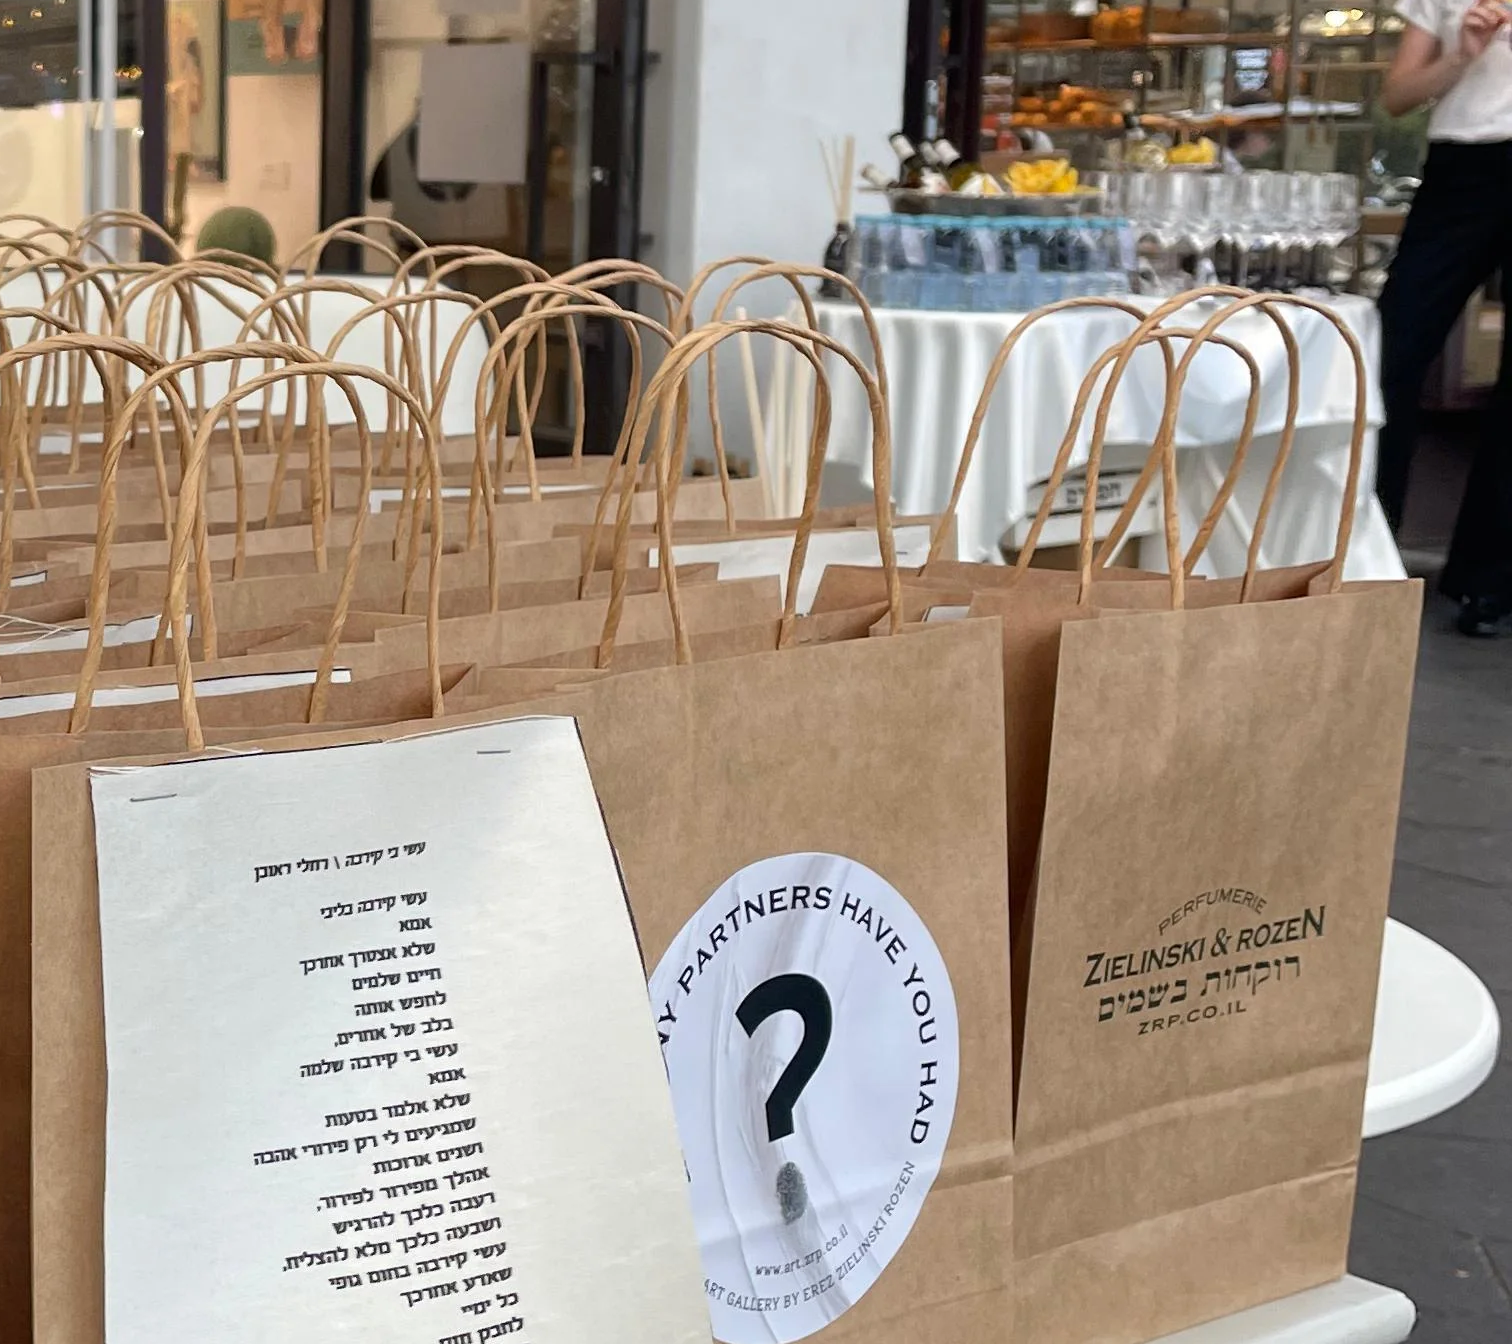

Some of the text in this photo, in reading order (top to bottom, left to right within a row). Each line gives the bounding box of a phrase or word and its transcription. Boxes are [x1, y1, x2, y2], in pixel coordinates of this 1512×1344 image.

[676, 885, 833, 997] PARTNERS
[840, 893, 908, 965] HAVE
[1083, 905, 1326, 988] ZIELINSKI & ROZEN
[1158, 887, 1268, 937] PERFUMERIE
[903, 962, 937, 1045] YOU
[1097, 956, 1301, 1023] רוקחות בשמים
[1137, 1000, 1247, 1036] ZRP.CO.IL
[910, 1060, 938, 1145] HAD
[726, 1291, 781, 1312] GALLERY
[783, 1291, 800, 1309] BY
[803, 1273, 836, 1303] EREZ
[835, 1215, 888, 1281] ZIELINSKI
[883, 1160, 916, 1217] ROZEN
[755, 1223, 849, 1276] www.art.zrp.co.il
